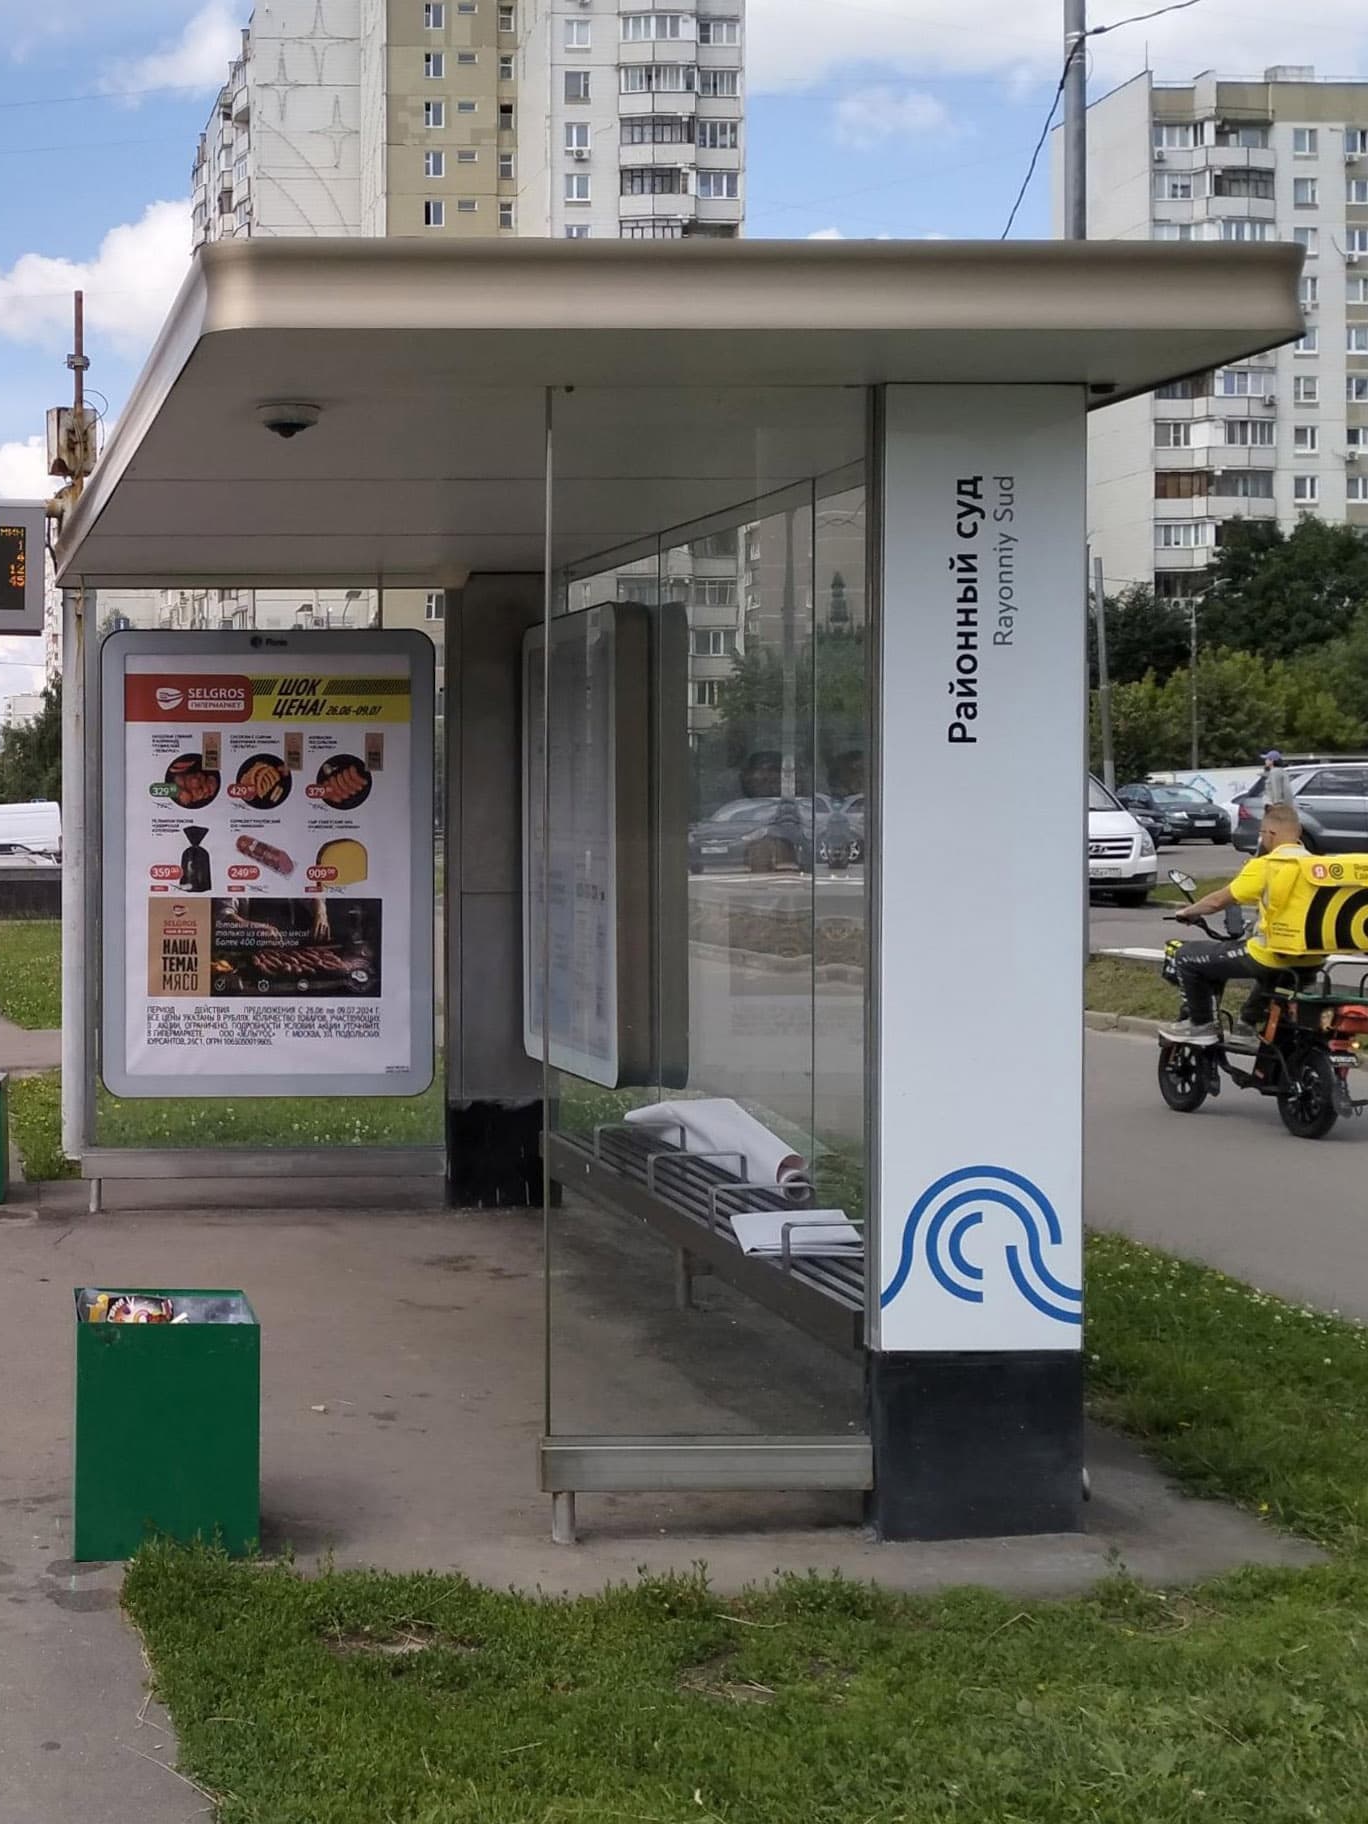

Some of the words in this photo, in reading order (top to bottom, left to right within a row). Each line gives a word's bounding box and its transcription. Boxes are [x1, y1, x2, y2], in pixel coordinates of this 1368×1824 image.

[956, 475, 985, 539] суд
[993, 476, 1015, 523] Sud
[993, 532, 1019, 646] Rayonniy
[948, 554, 979, 744] Районный
[187, 687, 245, 700] SELGROS
[278, 677, 322, 697] ШОК
[190, 701, 243, 710] ГИПЕРМАРКЕТ
[272, 698, 327, 719] ЦЕНА!
[151, 867, 170, 879] 359
[230, 868, 249, 879] 249
[307, 869, 327, 880] 909
[163, 939, 198, 955] НАША
[239, 938, 256, 946] 400
[162, 956, 198, 972] ТЕМА!
[162, 973, 198, 991] МЯСО
